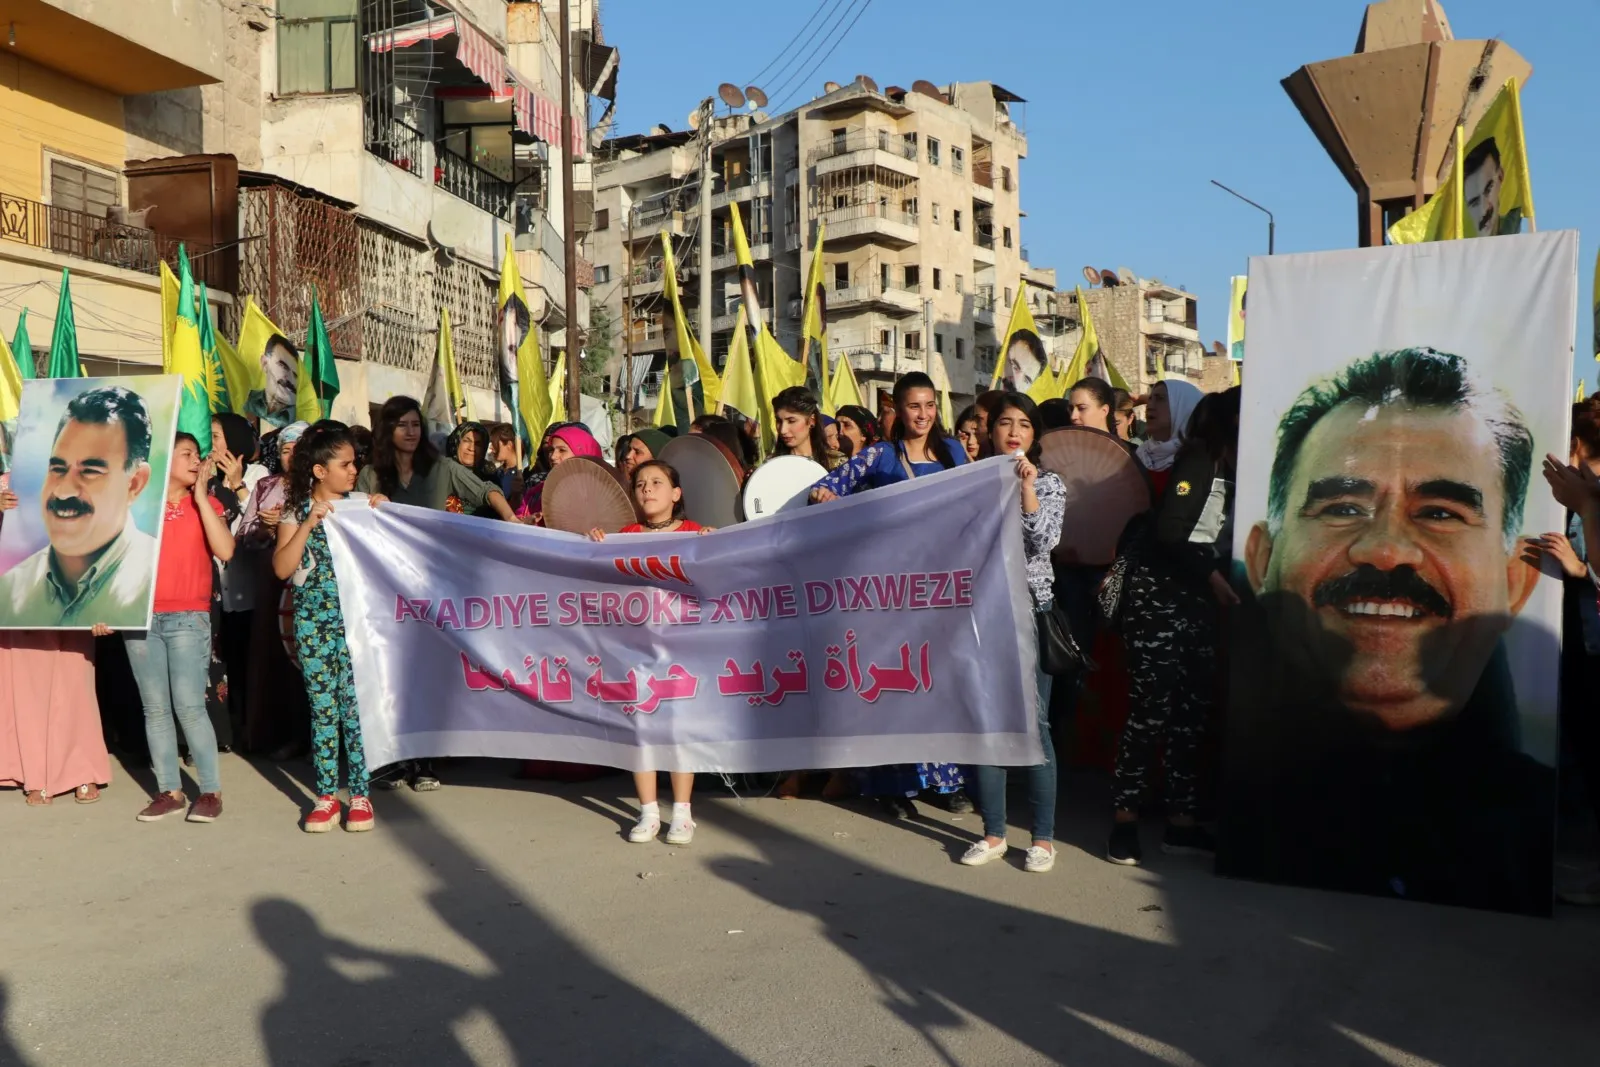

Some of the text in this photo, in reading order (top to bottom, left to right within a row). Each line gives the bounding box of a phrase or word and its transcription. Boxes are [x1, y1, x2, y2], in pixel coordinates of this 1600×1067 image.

[395, 568, 973, 629] AZADIYE SEROKE XWE DIXWEZE
[585, 654, 699, 714] حرية
[717, 650, 808, 707] تريد
[823, 629, 933, 703] المرأة
